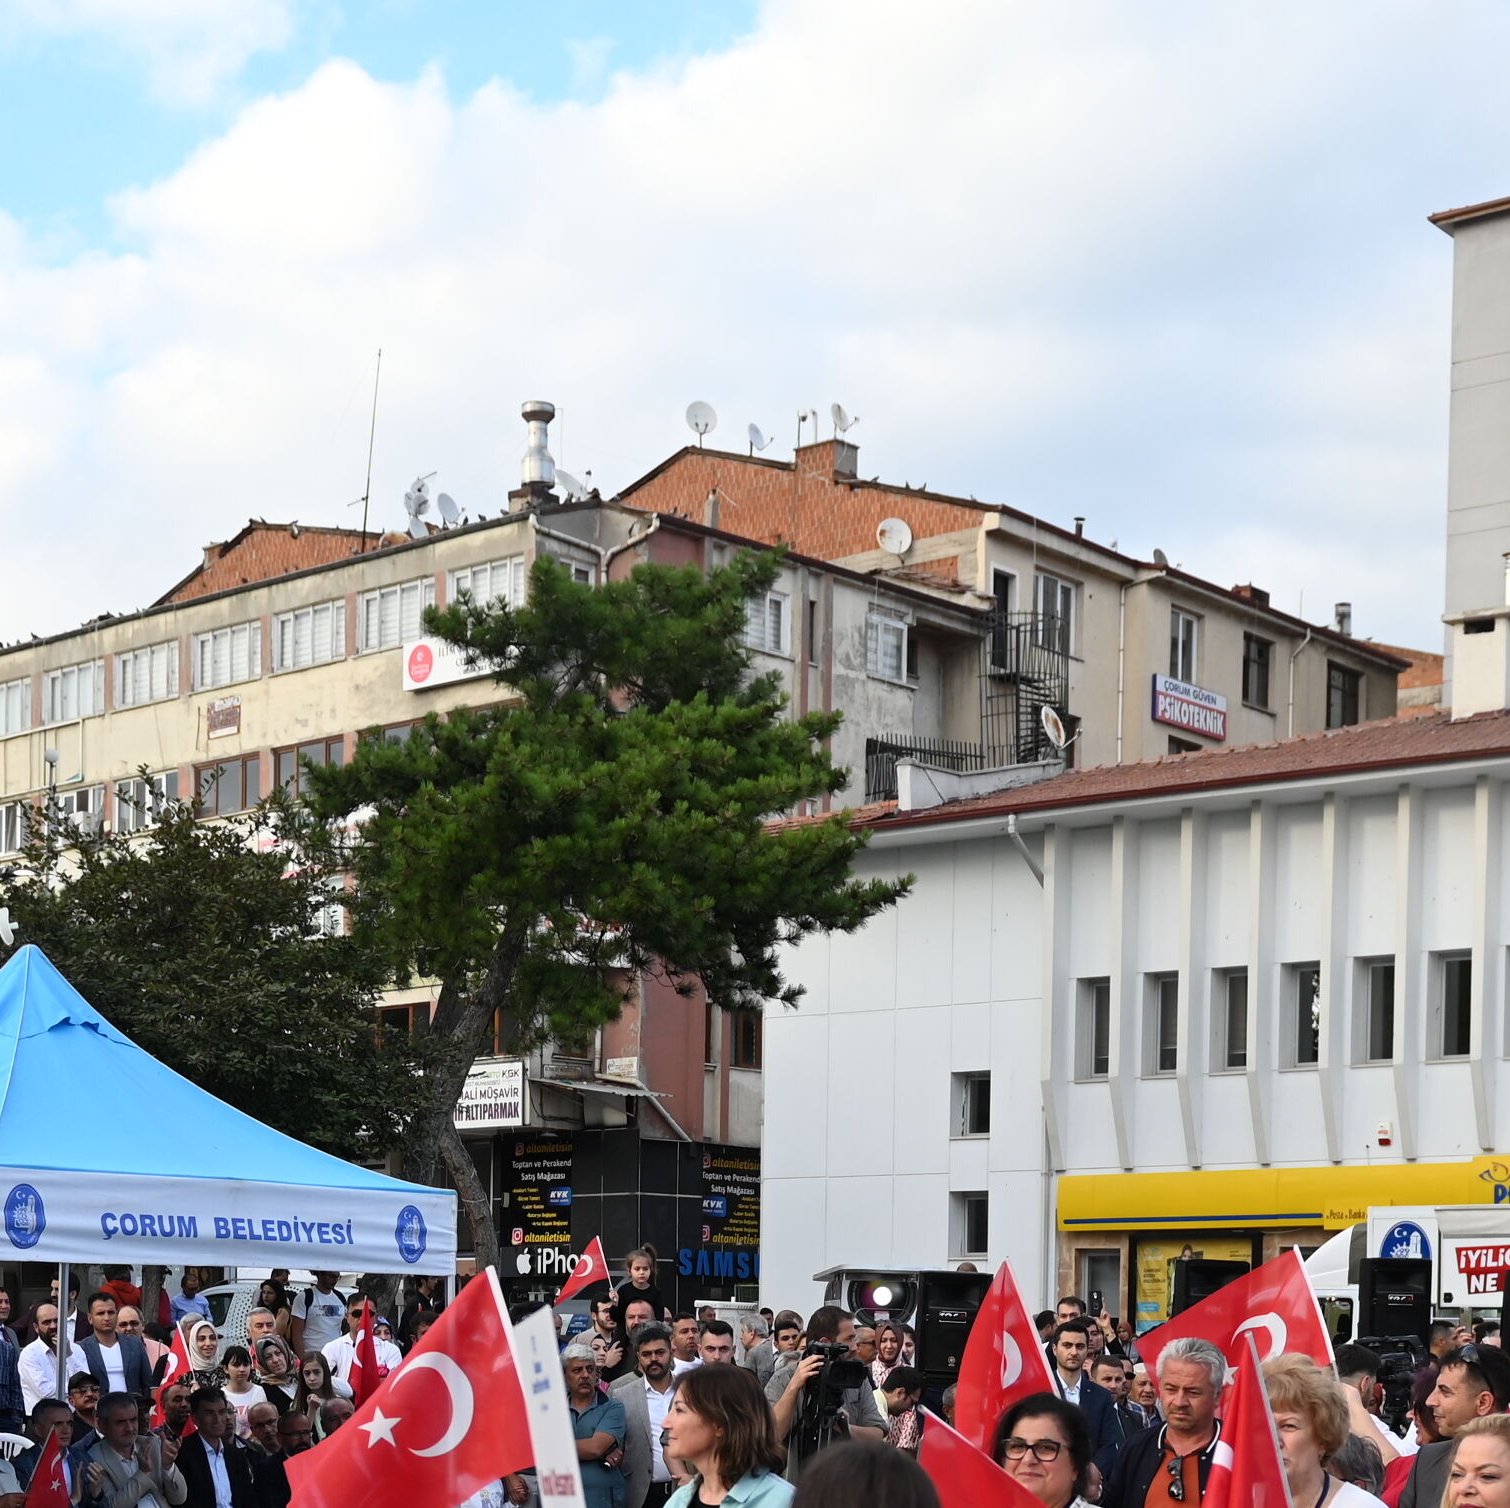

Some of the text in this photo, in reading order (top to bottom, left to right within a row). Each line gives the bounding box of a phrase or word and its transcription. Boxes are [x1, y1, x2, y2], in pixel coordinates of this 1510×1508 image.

[1164, 680, 1217, 706] ÇORUM GÜVEN
[501, 1068, 520, 1079] KGK
[479, 1084, 520, 1102] MÜŞAVİR
[465, 1101, 520, 1121] ALTIPARMAK
[512, 1160, 533, 1171] Toptan
[534, 1161, 542, 1169] ve
[521, 1172, 566, 1182] Satış Mağazası
[724, 1174, 732, 1182] ve
[550, 1190, 569, 1199] KVK
[711, 1184, 755, 1196] Satış Mağazası
[702, 1199, 724, 1209] KVK
[100, 1211, 355, 1246] ÇORUM BELEDİYESİ
[1470, 1273, 1499, 1293] NE
